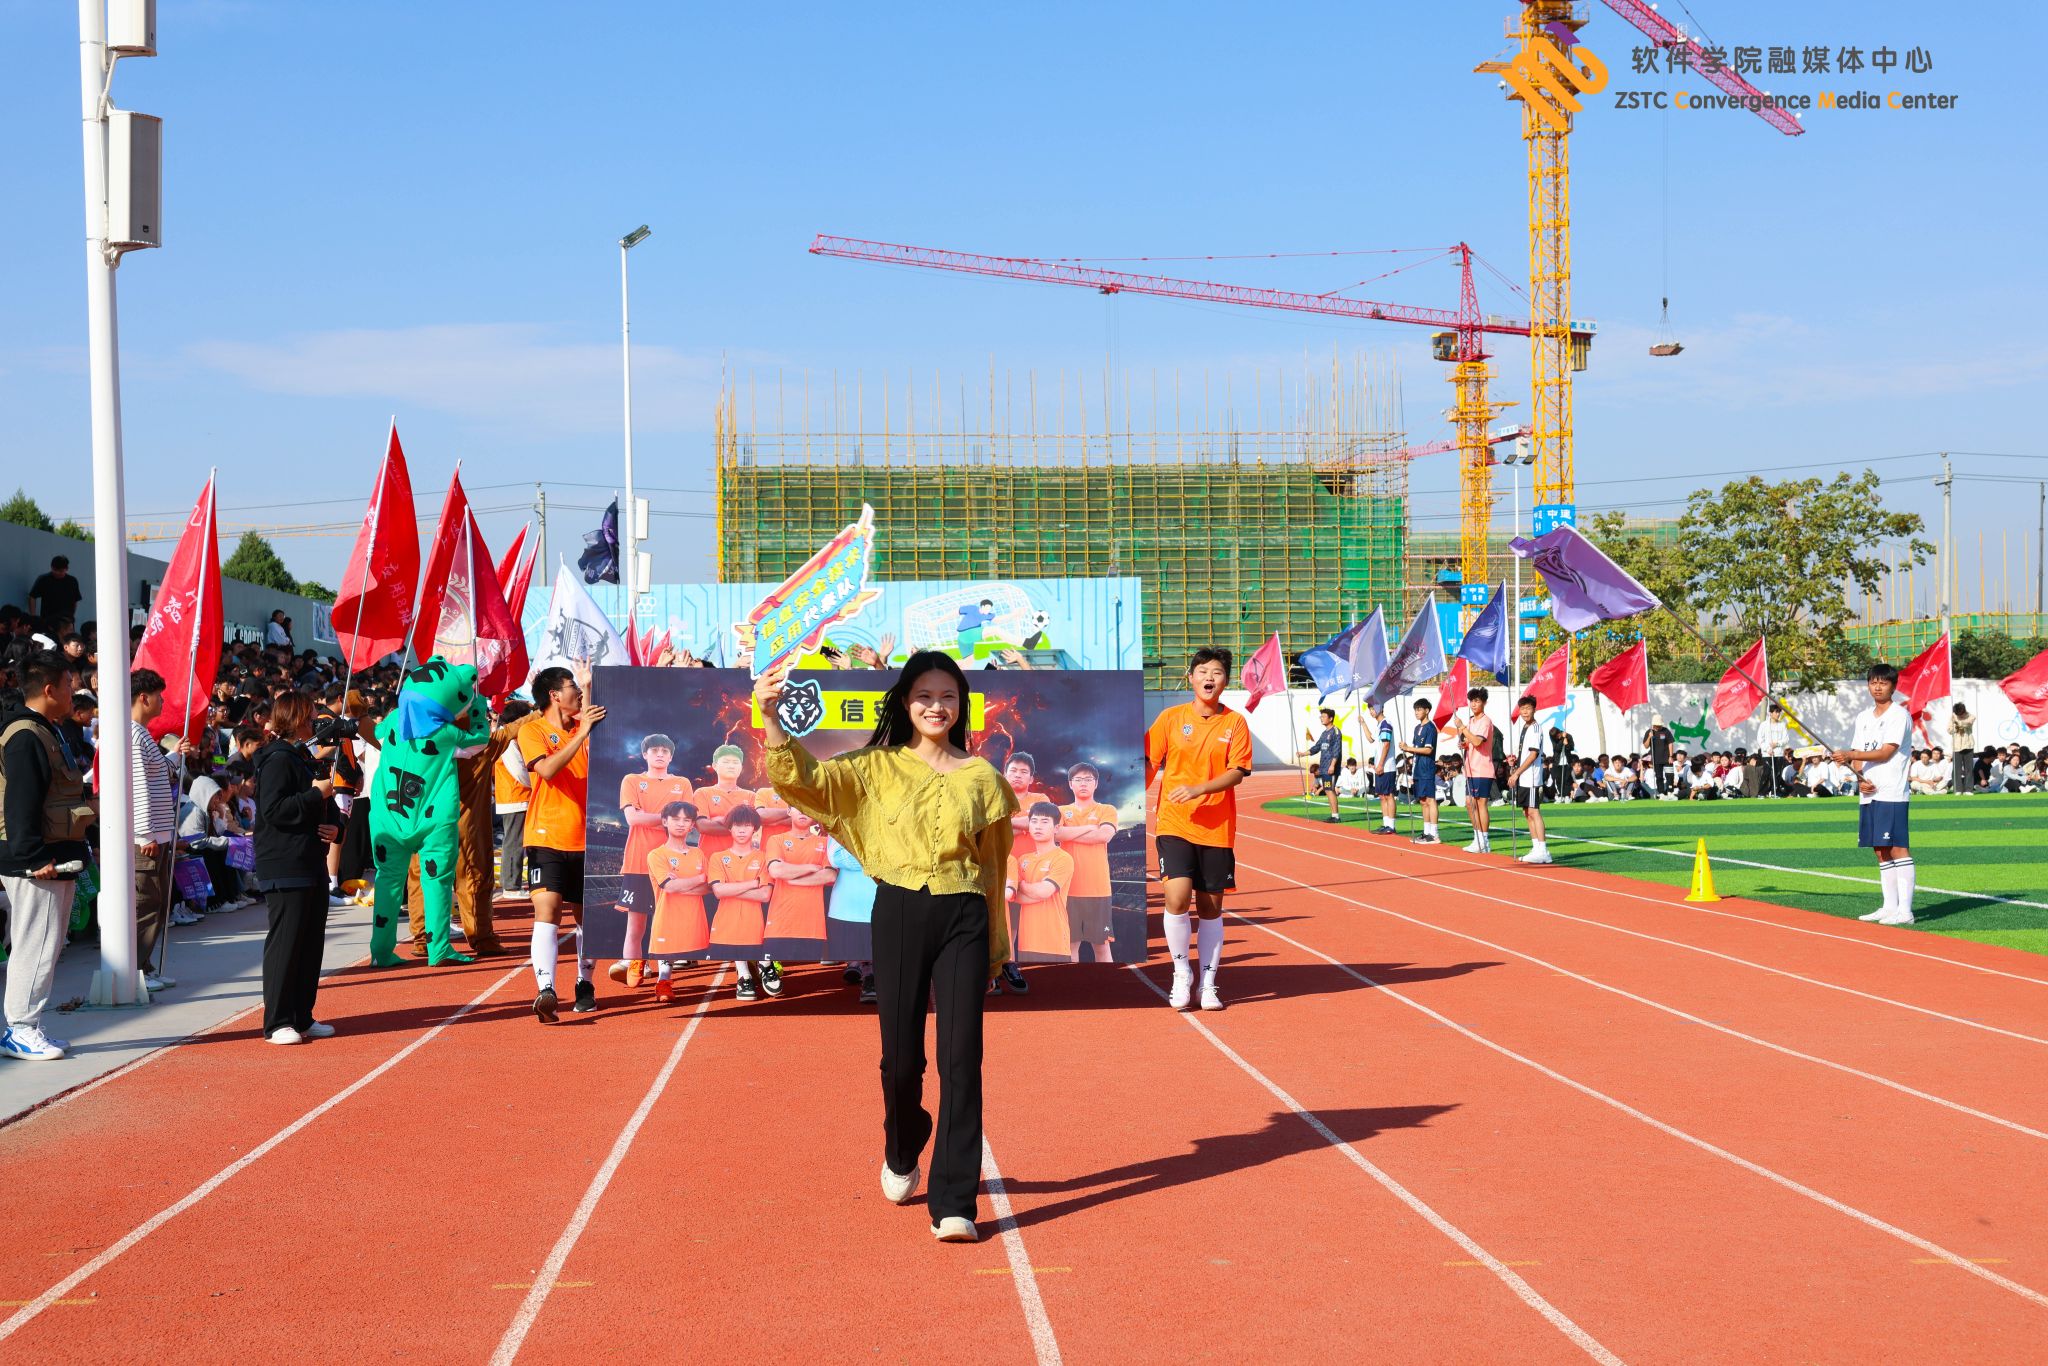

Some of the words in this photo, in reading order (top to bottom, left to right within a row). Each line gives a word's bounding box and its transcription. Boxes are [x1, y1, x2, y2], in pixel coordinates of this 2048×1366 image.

[769, 577, 856, 658] 应用代表队
[621, 889, 635, 905] 24
